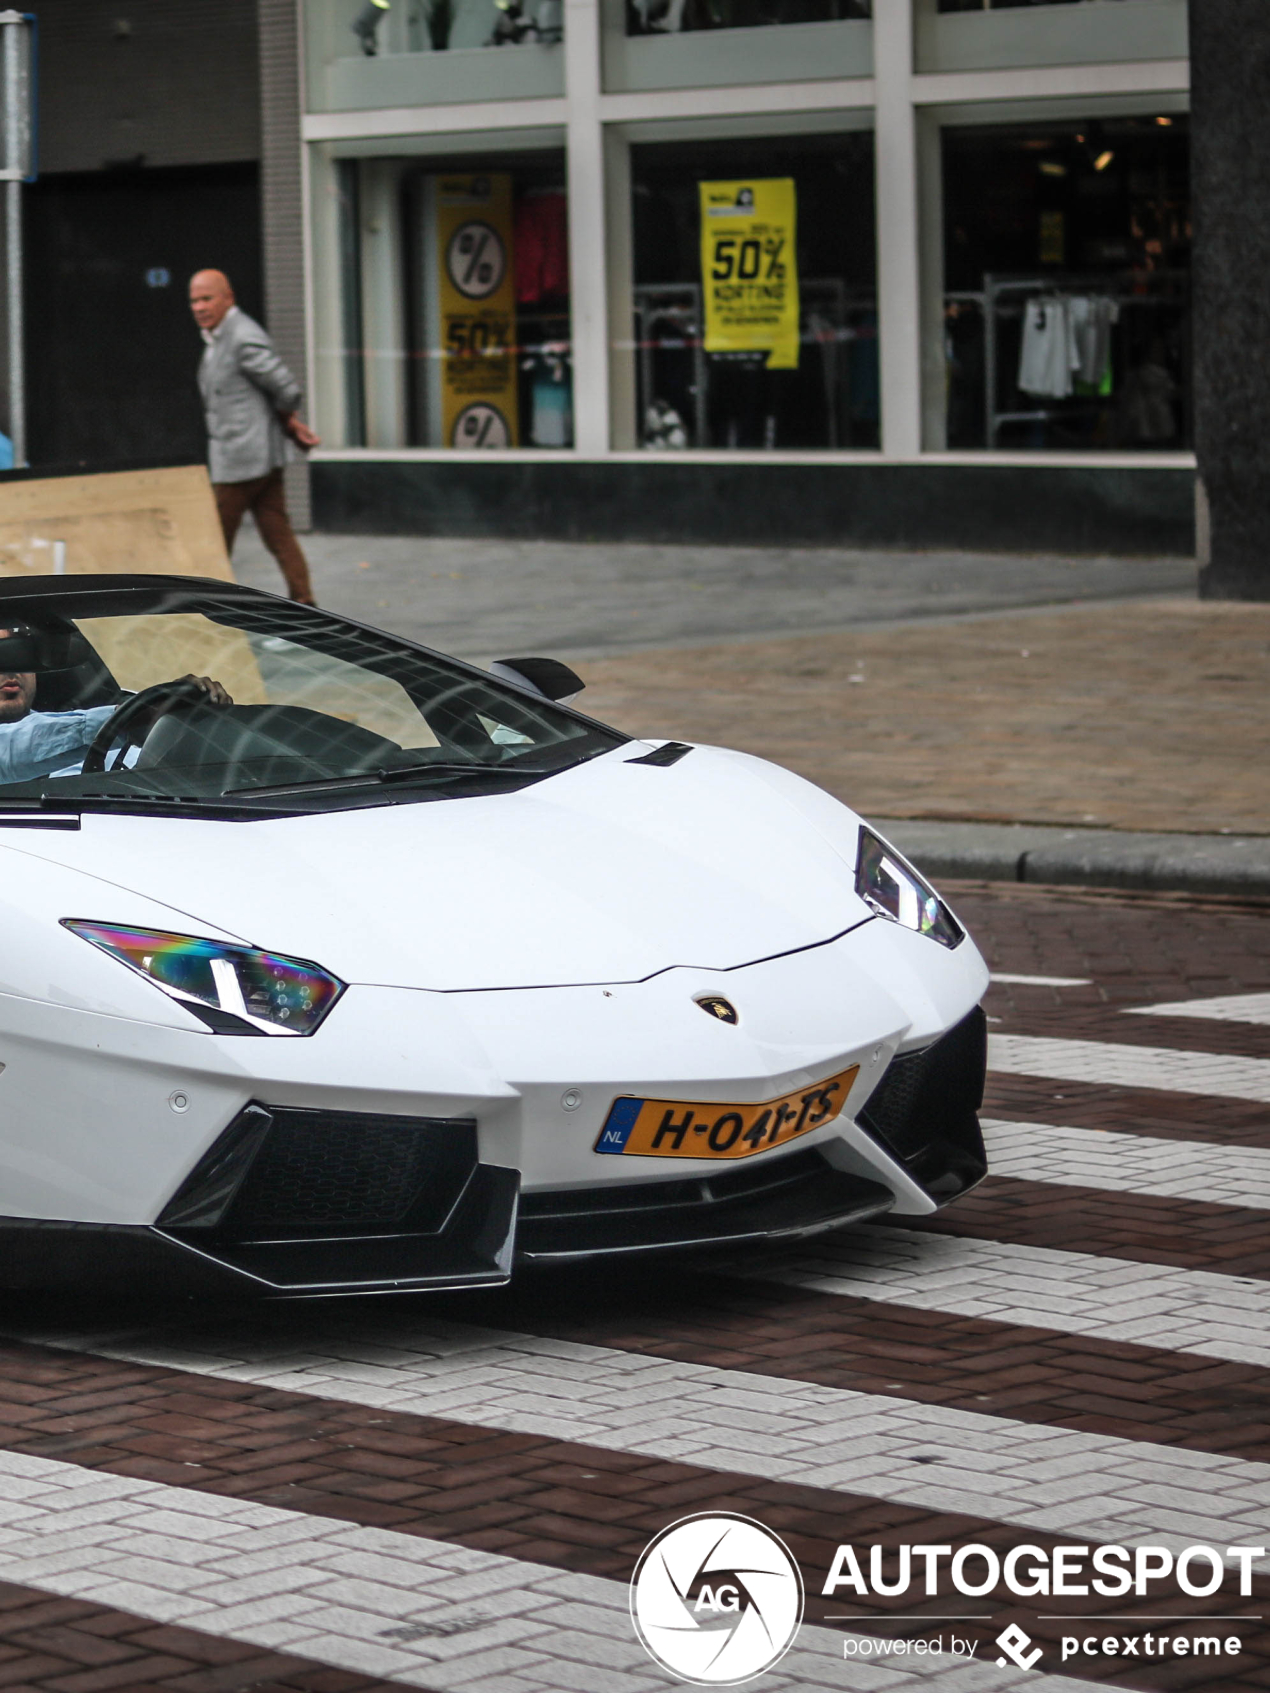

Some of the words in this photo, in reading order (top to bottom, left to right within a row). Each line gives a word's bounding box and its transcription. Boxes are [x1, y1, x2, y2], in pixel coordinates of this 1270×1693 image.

[712, 238, 786, 280] 50%
[603, 1130, 623, 1144] NL
[651, 1082, 840, 1152] H-041-TS
